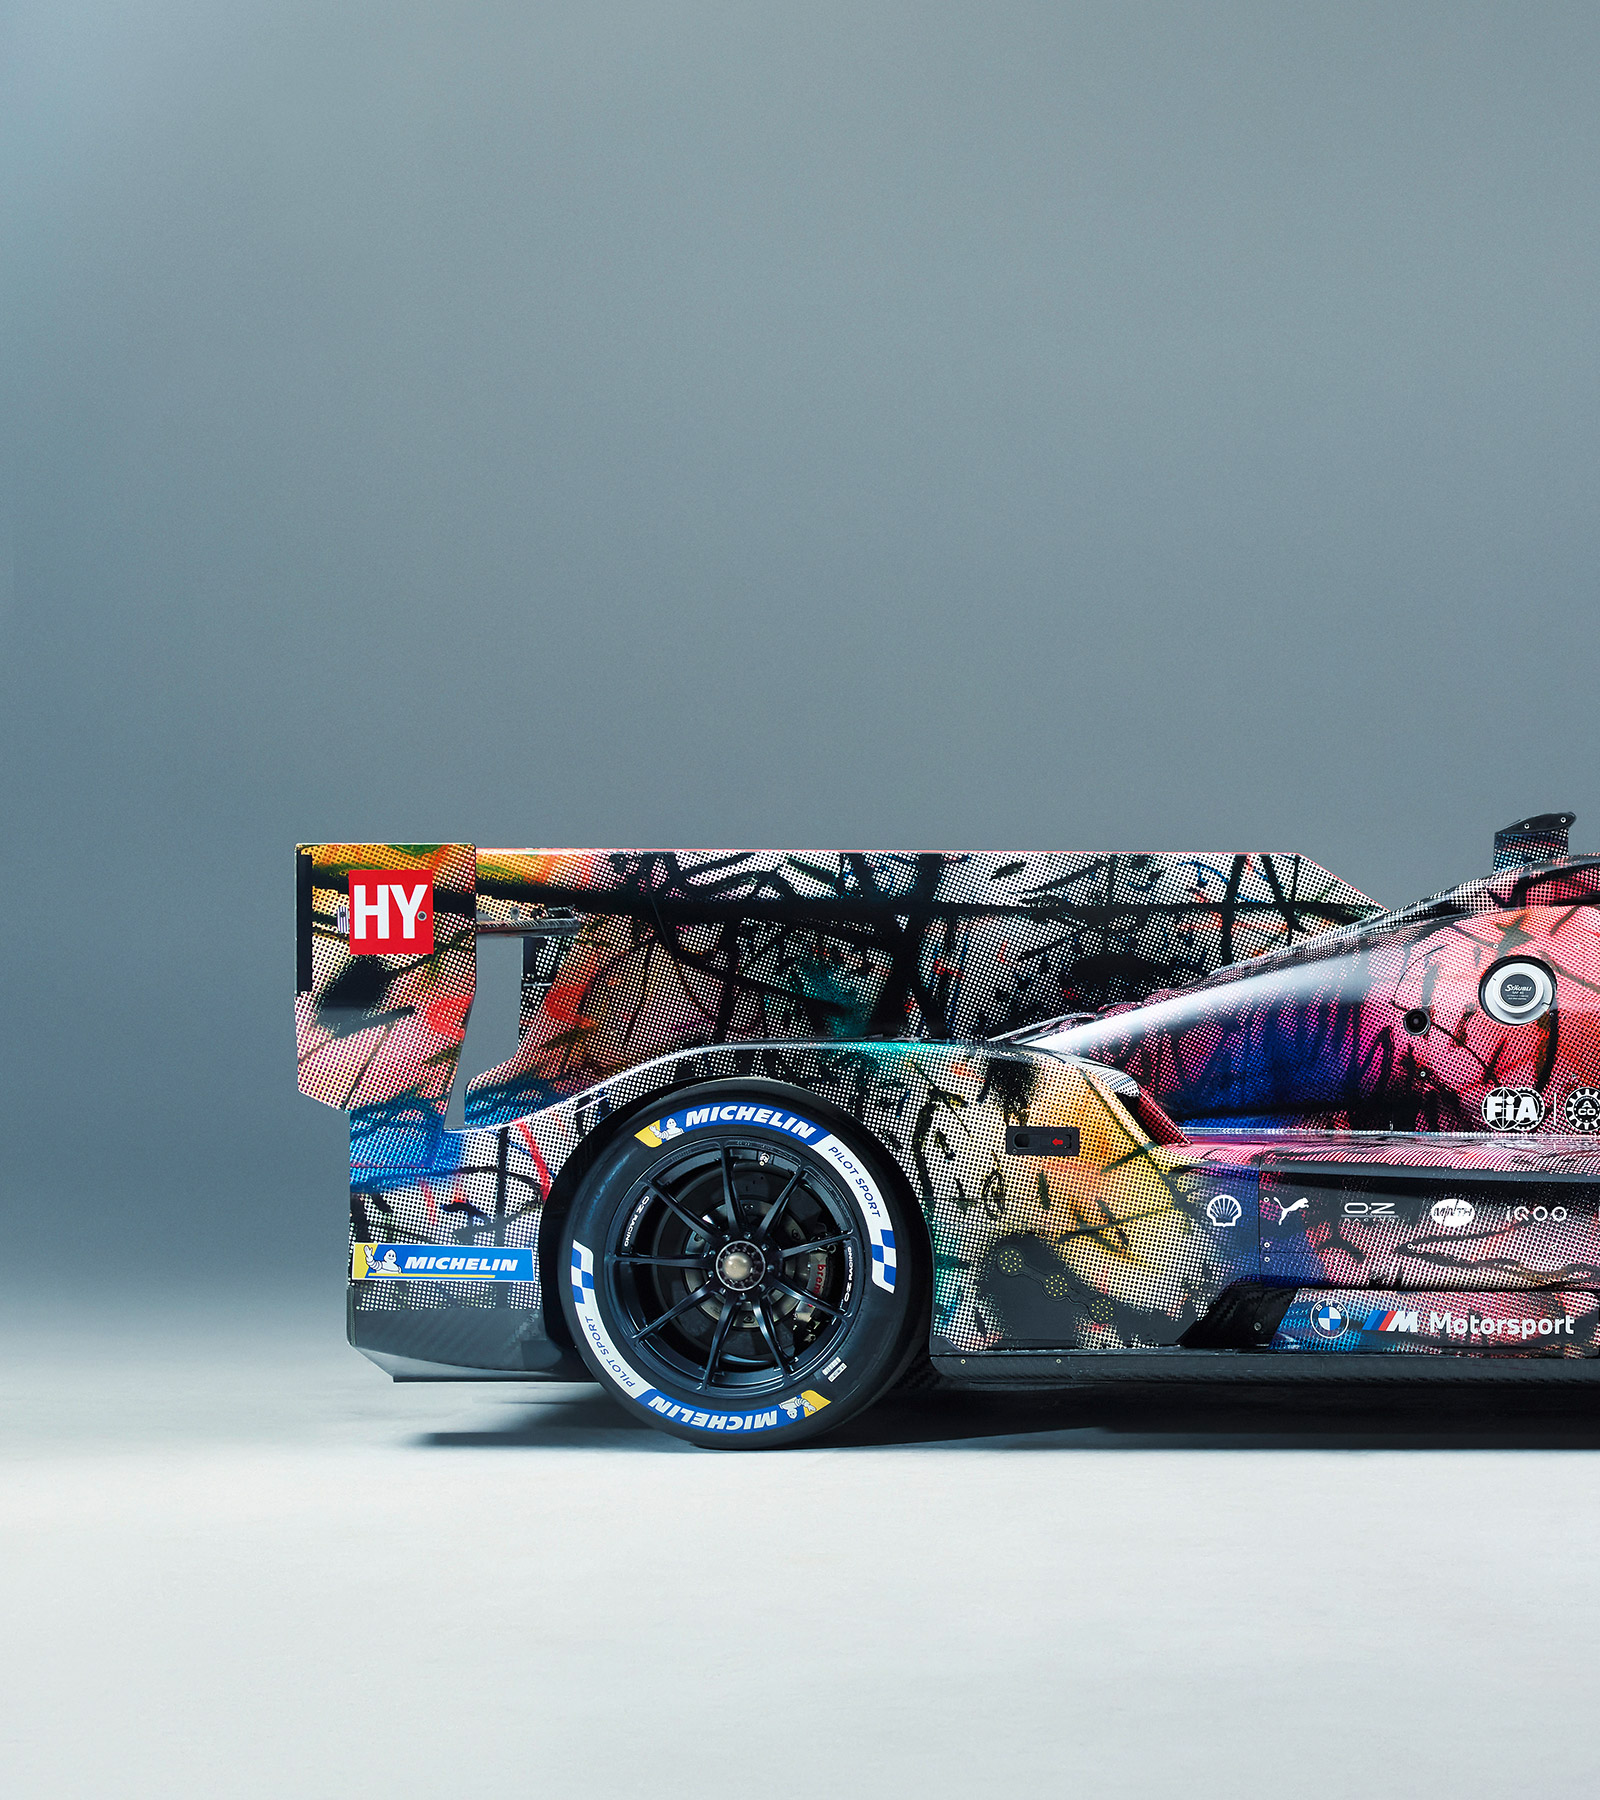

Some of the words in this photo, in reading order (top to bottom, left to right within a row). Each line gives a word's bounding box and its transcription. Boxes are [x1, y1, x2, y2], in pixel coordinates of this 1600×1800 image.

[354, 884, 428, 940] HY
[685, 1104, 817, 1139] MICHELIN
[828, 1146, 860, 1176] PILOT
[855, 1178, 881, 1218] SPORT
[404, 1256, 518, 1272] MICHELIN
[585, 1315, 610, 1356] SPORT
[1430, 1312, 1576, 1340] Motorsport
[606, 1358, 635, 1388] PILOT
[648, 1395, 778, 1430] MICHELIN
